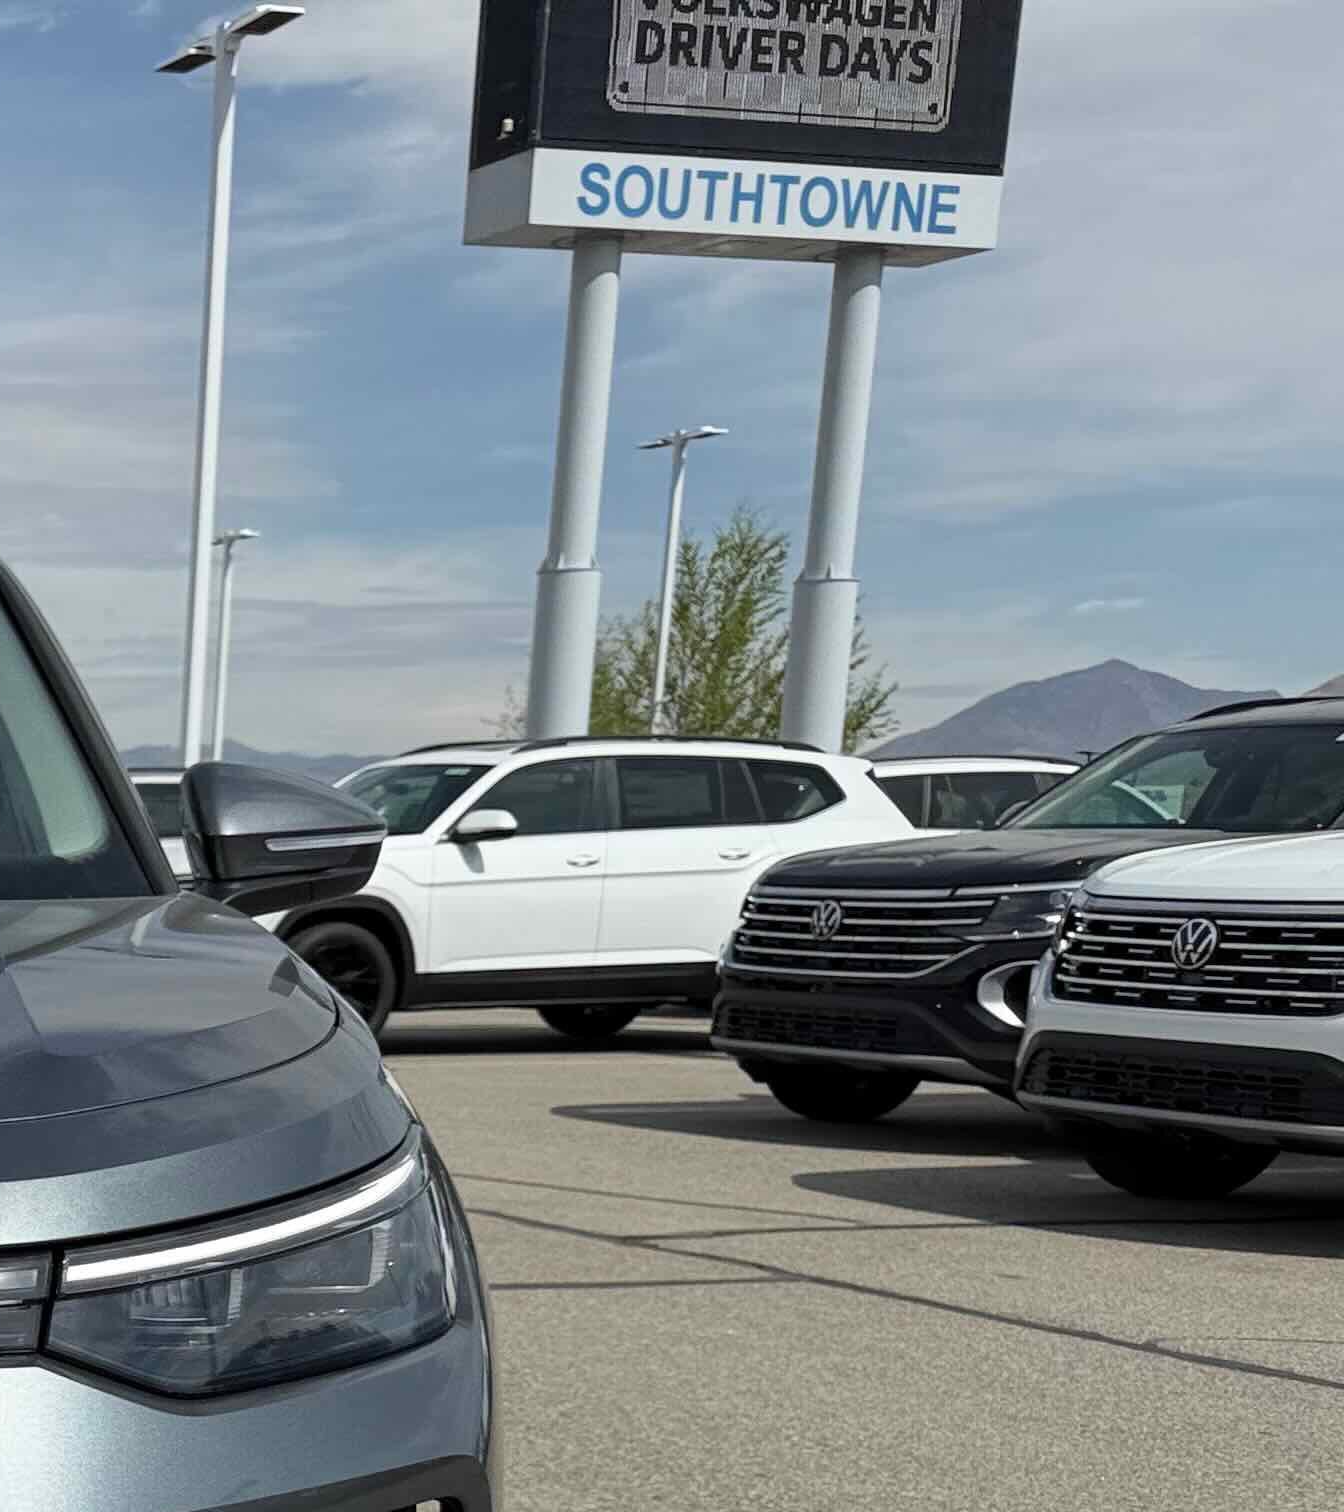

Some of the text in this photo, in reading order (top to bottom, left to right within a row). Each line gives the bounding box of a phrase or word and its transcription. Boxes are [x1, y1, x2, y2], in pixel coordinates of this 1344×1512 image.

[640, 0, 938, 31] WAGEN
[635, 20, 934, 84] DRIVER DAYS
[577, 163, 961, 234] SOUTHTOWNE
[1172, 918, 1217, 969] VW
